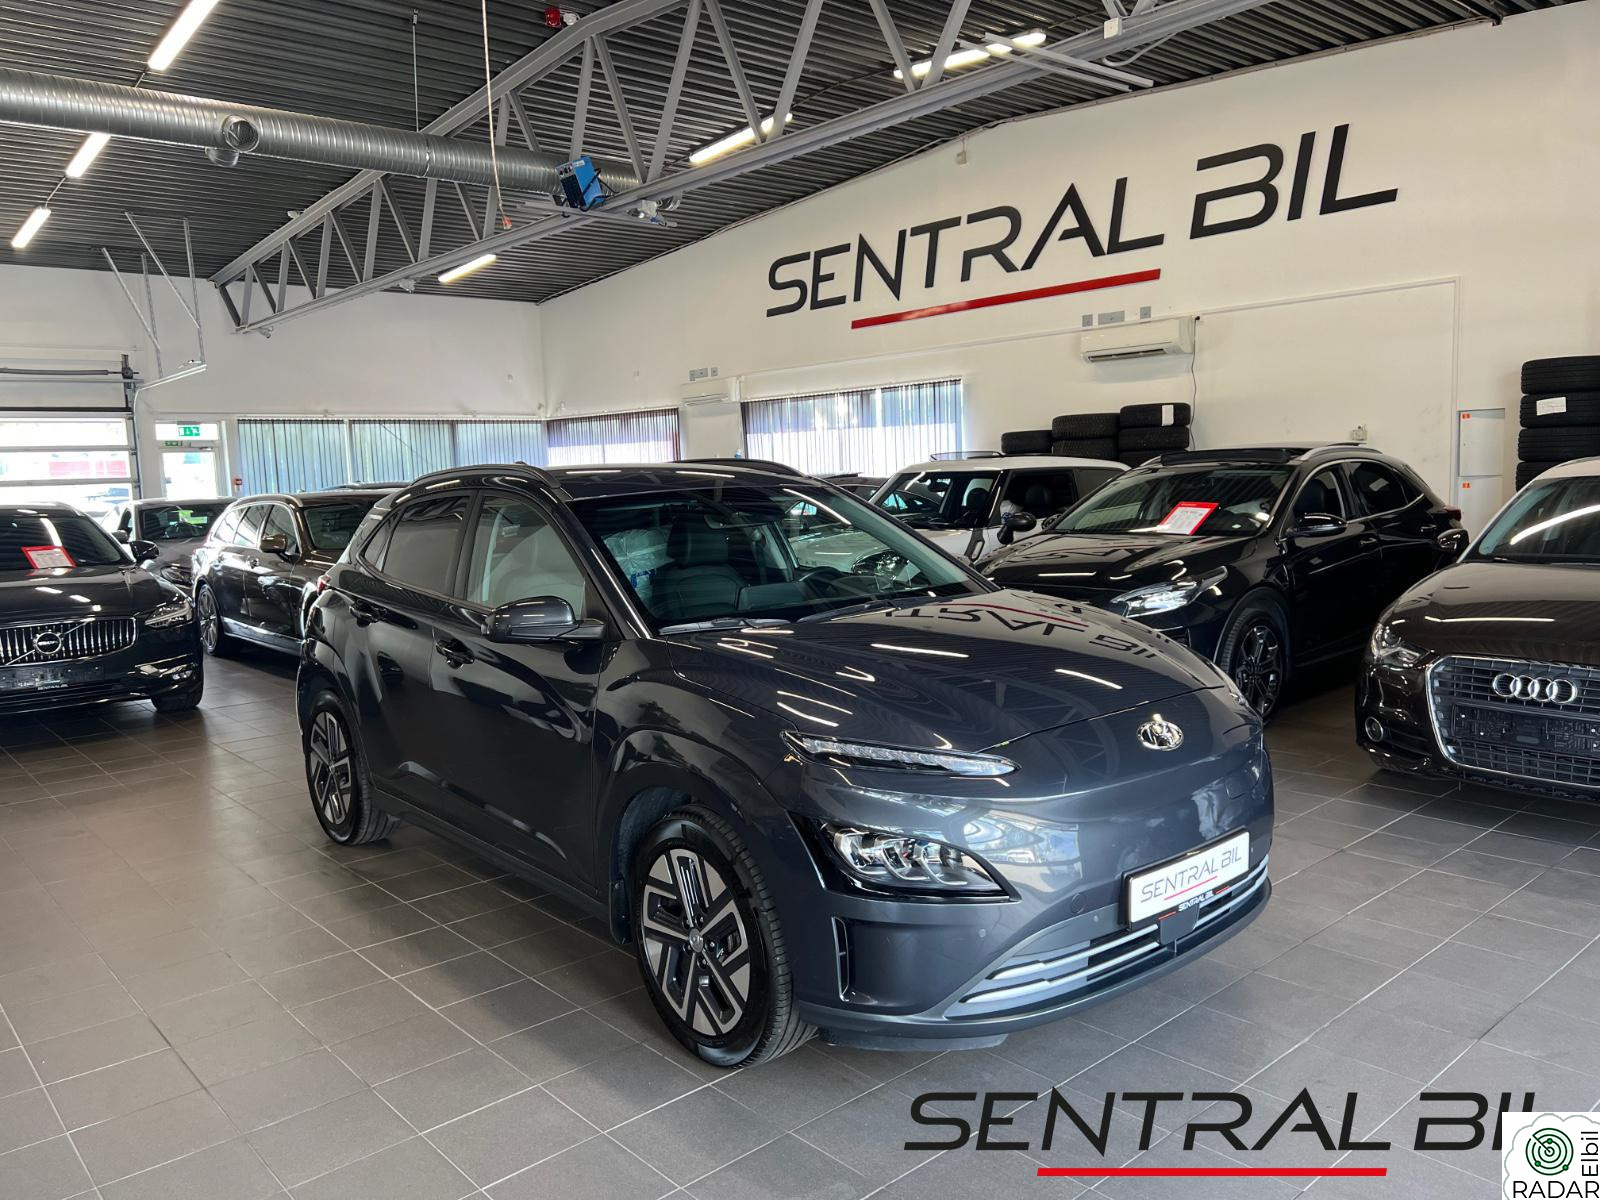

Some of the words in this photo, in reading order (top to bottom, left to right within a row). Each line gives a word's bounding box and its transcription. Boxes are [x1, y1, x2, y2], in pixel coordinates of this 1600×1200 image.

[767, 177, 1165, 318] SENTRAL
[1189, 123, 1399, 240] BIL
[1141, 857, 1219, 903] SENTRAL
[1221, 846, 1242, 869] BIL
